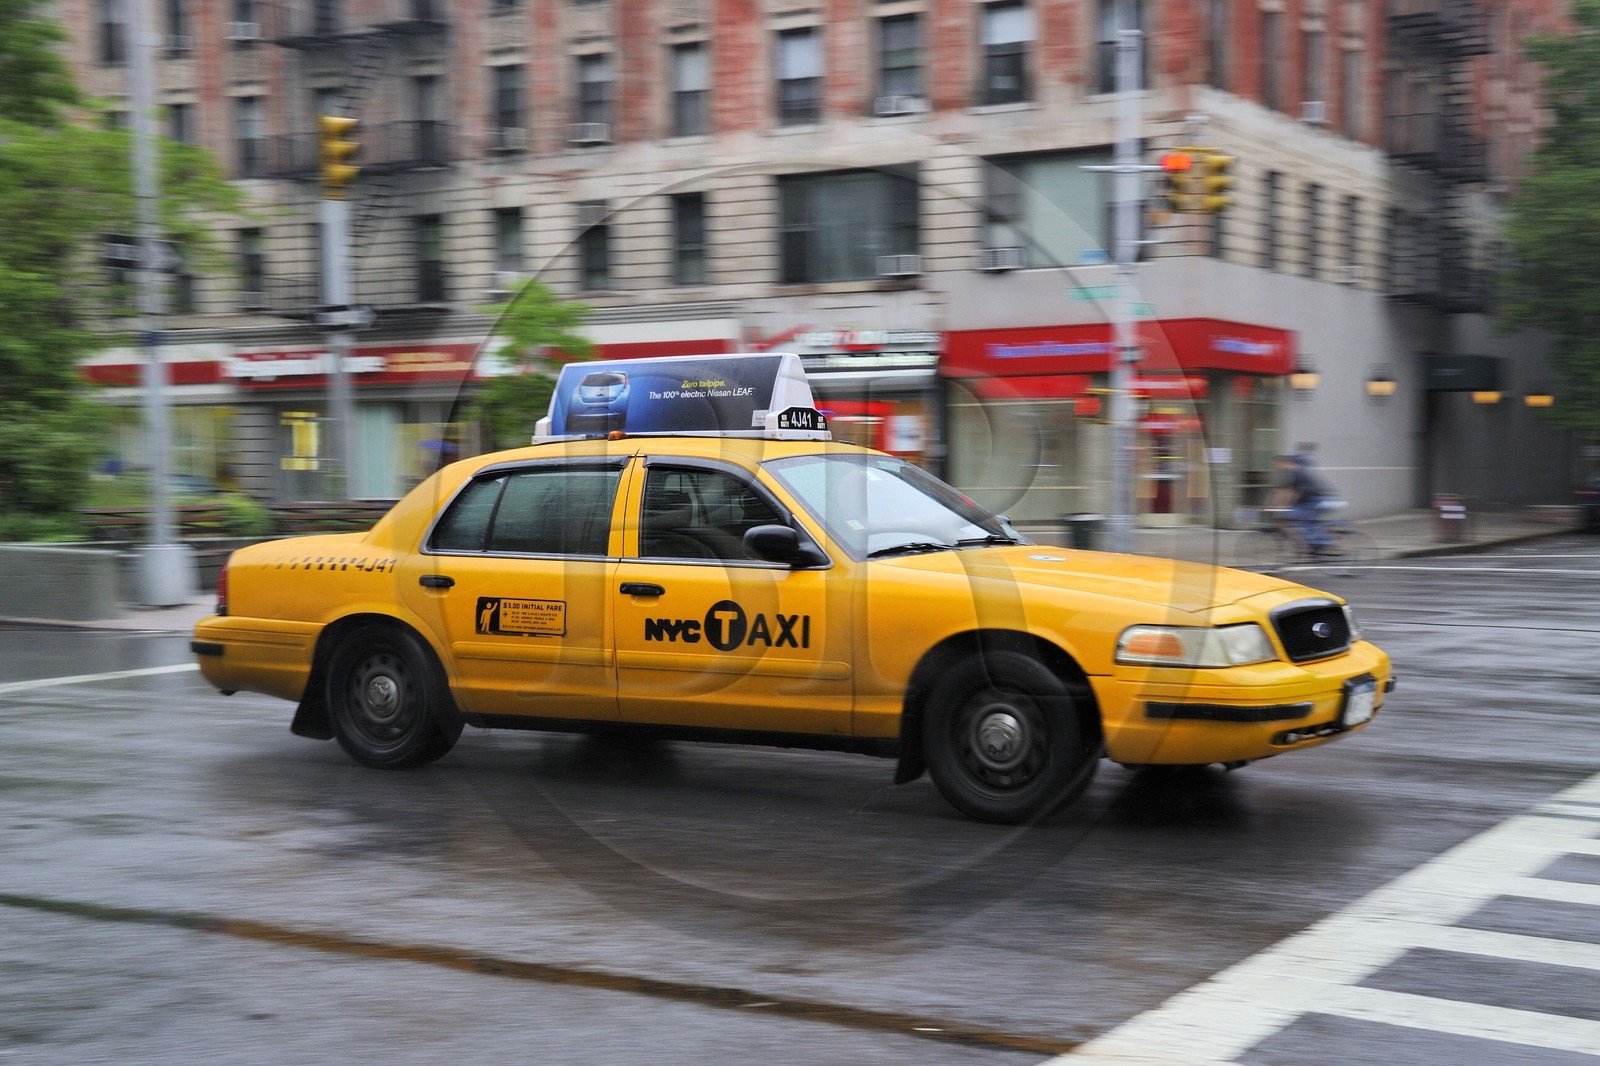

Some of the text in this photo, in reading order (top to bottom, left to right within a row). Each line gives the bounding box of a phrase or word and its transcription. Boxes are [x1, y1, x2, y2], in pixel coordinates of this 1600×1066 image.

[681, 380, 698, 389] Zero
[649, 391, 662, 399] The
[680, 389, 706, 399] electric
[707, 388, 732, 397] Nissan
[791, 411, 812, 428] 4J41
[356, 557, 398, 574] 4J41
[521, 603, 544, 611] INITIAL
[546, 604, 562, 612] FARE
[645, 618, 701, 643] NYC
